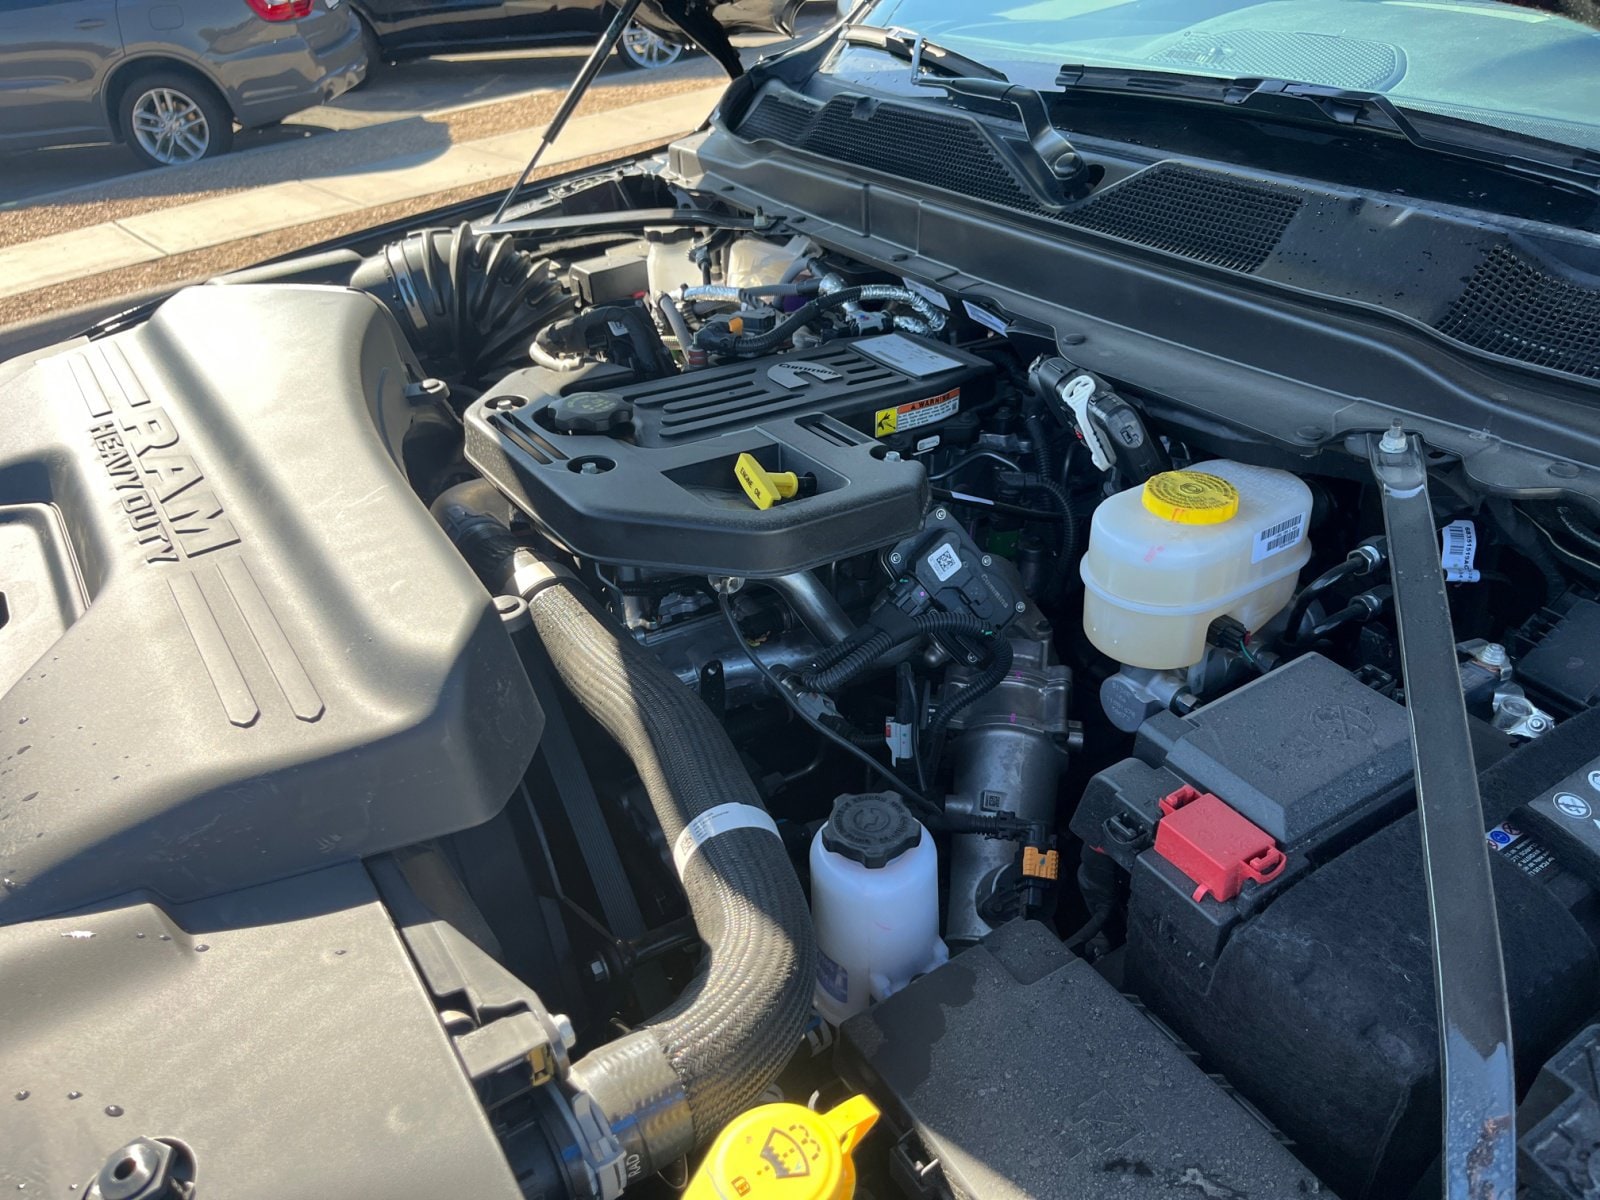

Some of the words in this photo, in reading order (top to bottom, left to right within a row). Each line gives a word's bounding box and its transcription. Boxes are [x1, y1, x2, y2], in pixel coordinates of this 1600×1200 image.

[779, 363, 838, 376] Cummins
[918, 393, 950, 408] WARNING
[89, 420, 144, 490] HEAVY
[121, 490, 180, 564] DUTY
[118, 406, 242, 559] RAM
[740, 467, 754, 488] ENGINE
[754, 488, 762, 500] OIL
[981, 573, 1009, 609] Cummins
[626, 1153, 641, 1178] RAD
